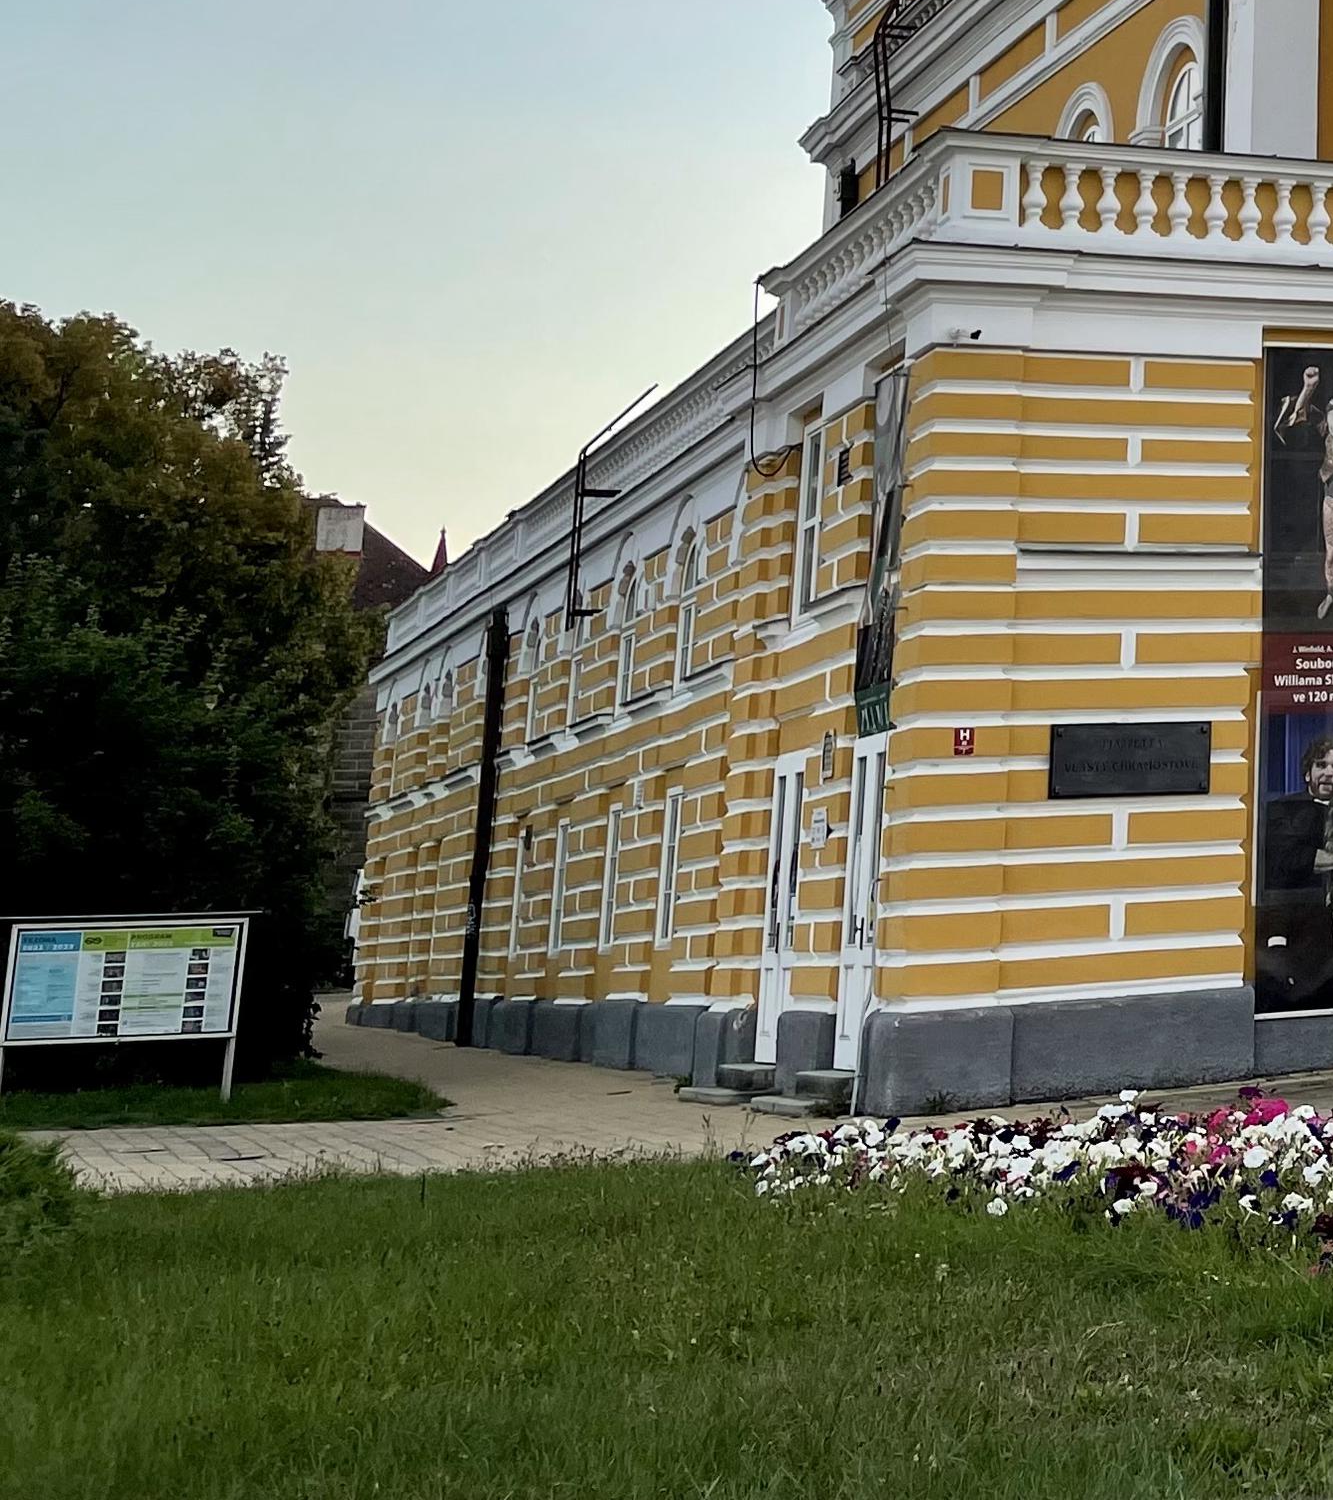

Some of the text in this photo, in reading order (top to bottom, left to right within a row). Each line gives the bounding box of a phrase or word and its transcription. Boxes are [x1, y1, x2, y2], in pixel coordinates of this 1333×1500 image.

[1274, 674, 1323, 687] Williama
[1293, 693, 1306, 703] ve
[1308, 690, 1328, 703] 120
